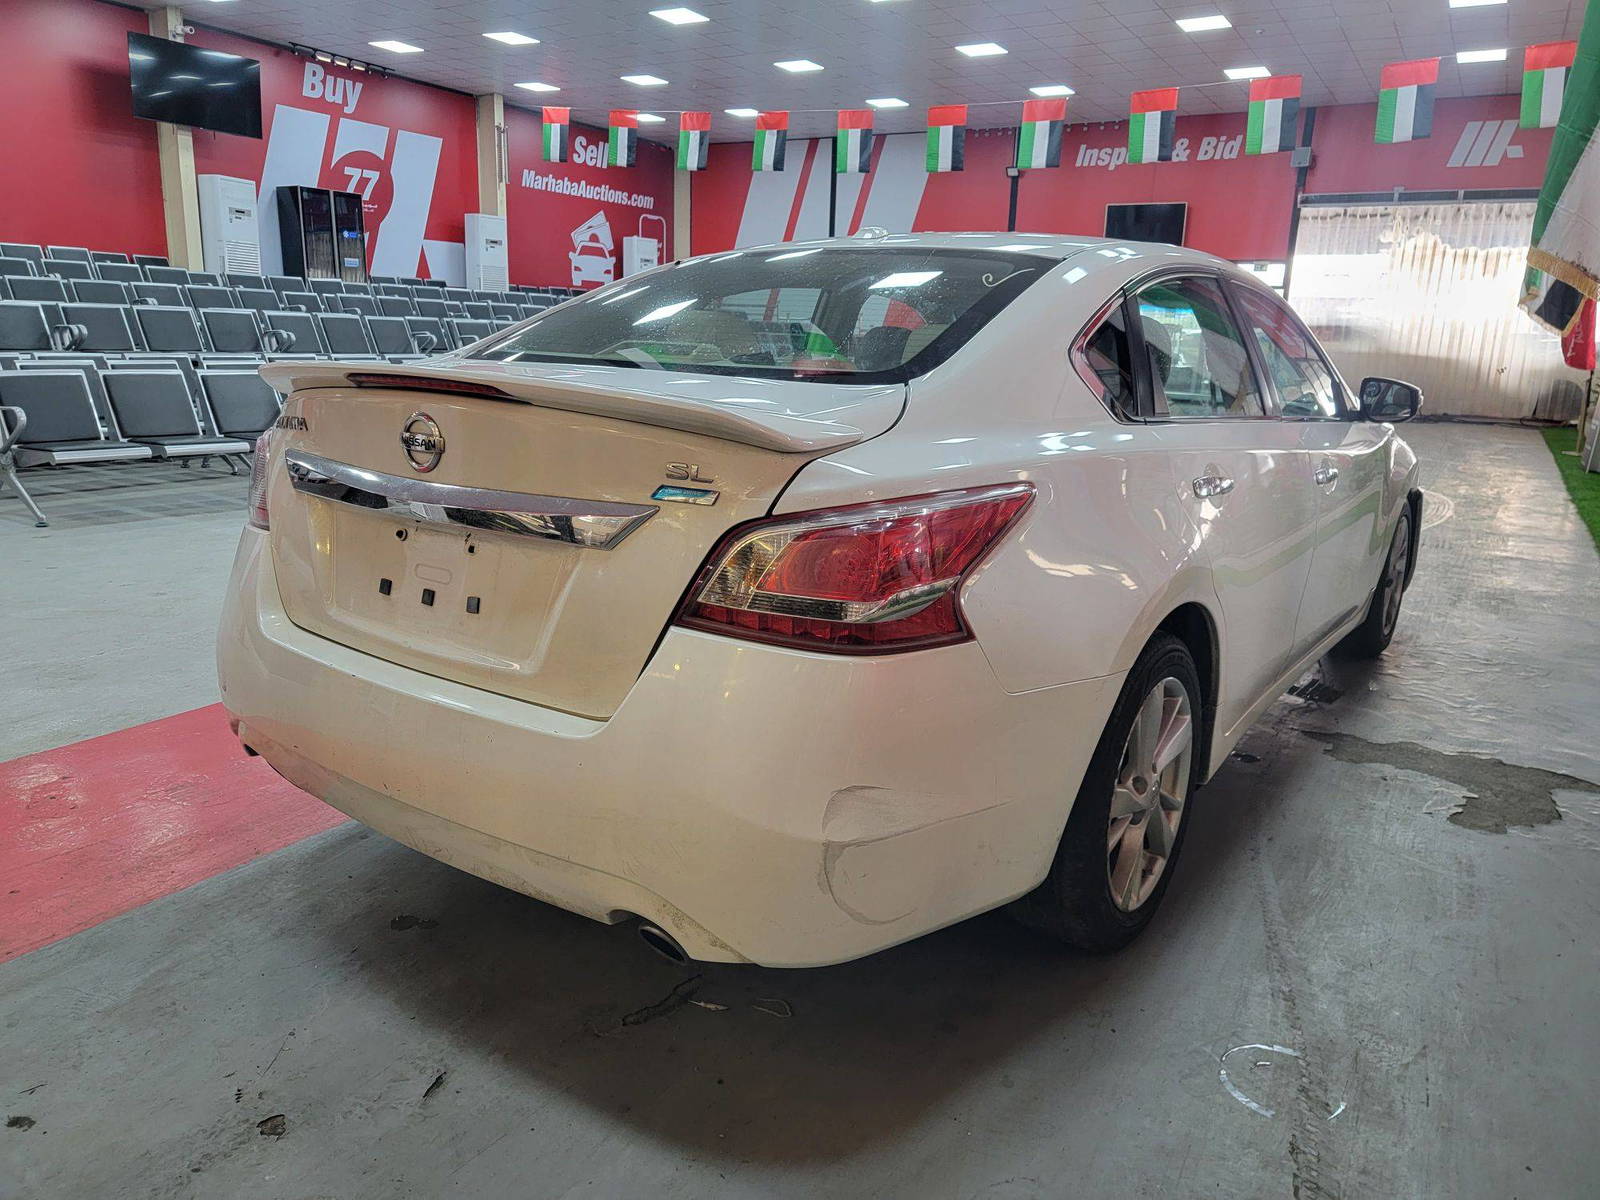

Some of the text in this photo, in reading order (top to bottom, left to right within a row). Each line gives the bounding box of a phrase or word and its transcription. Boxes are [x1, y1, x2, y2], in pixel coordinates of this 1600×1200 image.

[302, 61, 363, 114] Buy
[572, 135, 609, 169] Sell
[1171, 137, 1191, 163] &
[1196, 134, 1244, 162] Bid
[343, 166, 381, 201] 77
[521, 168, 655, 210] MarhabaAuctions.com
[664, 461, 714, 484] SL
